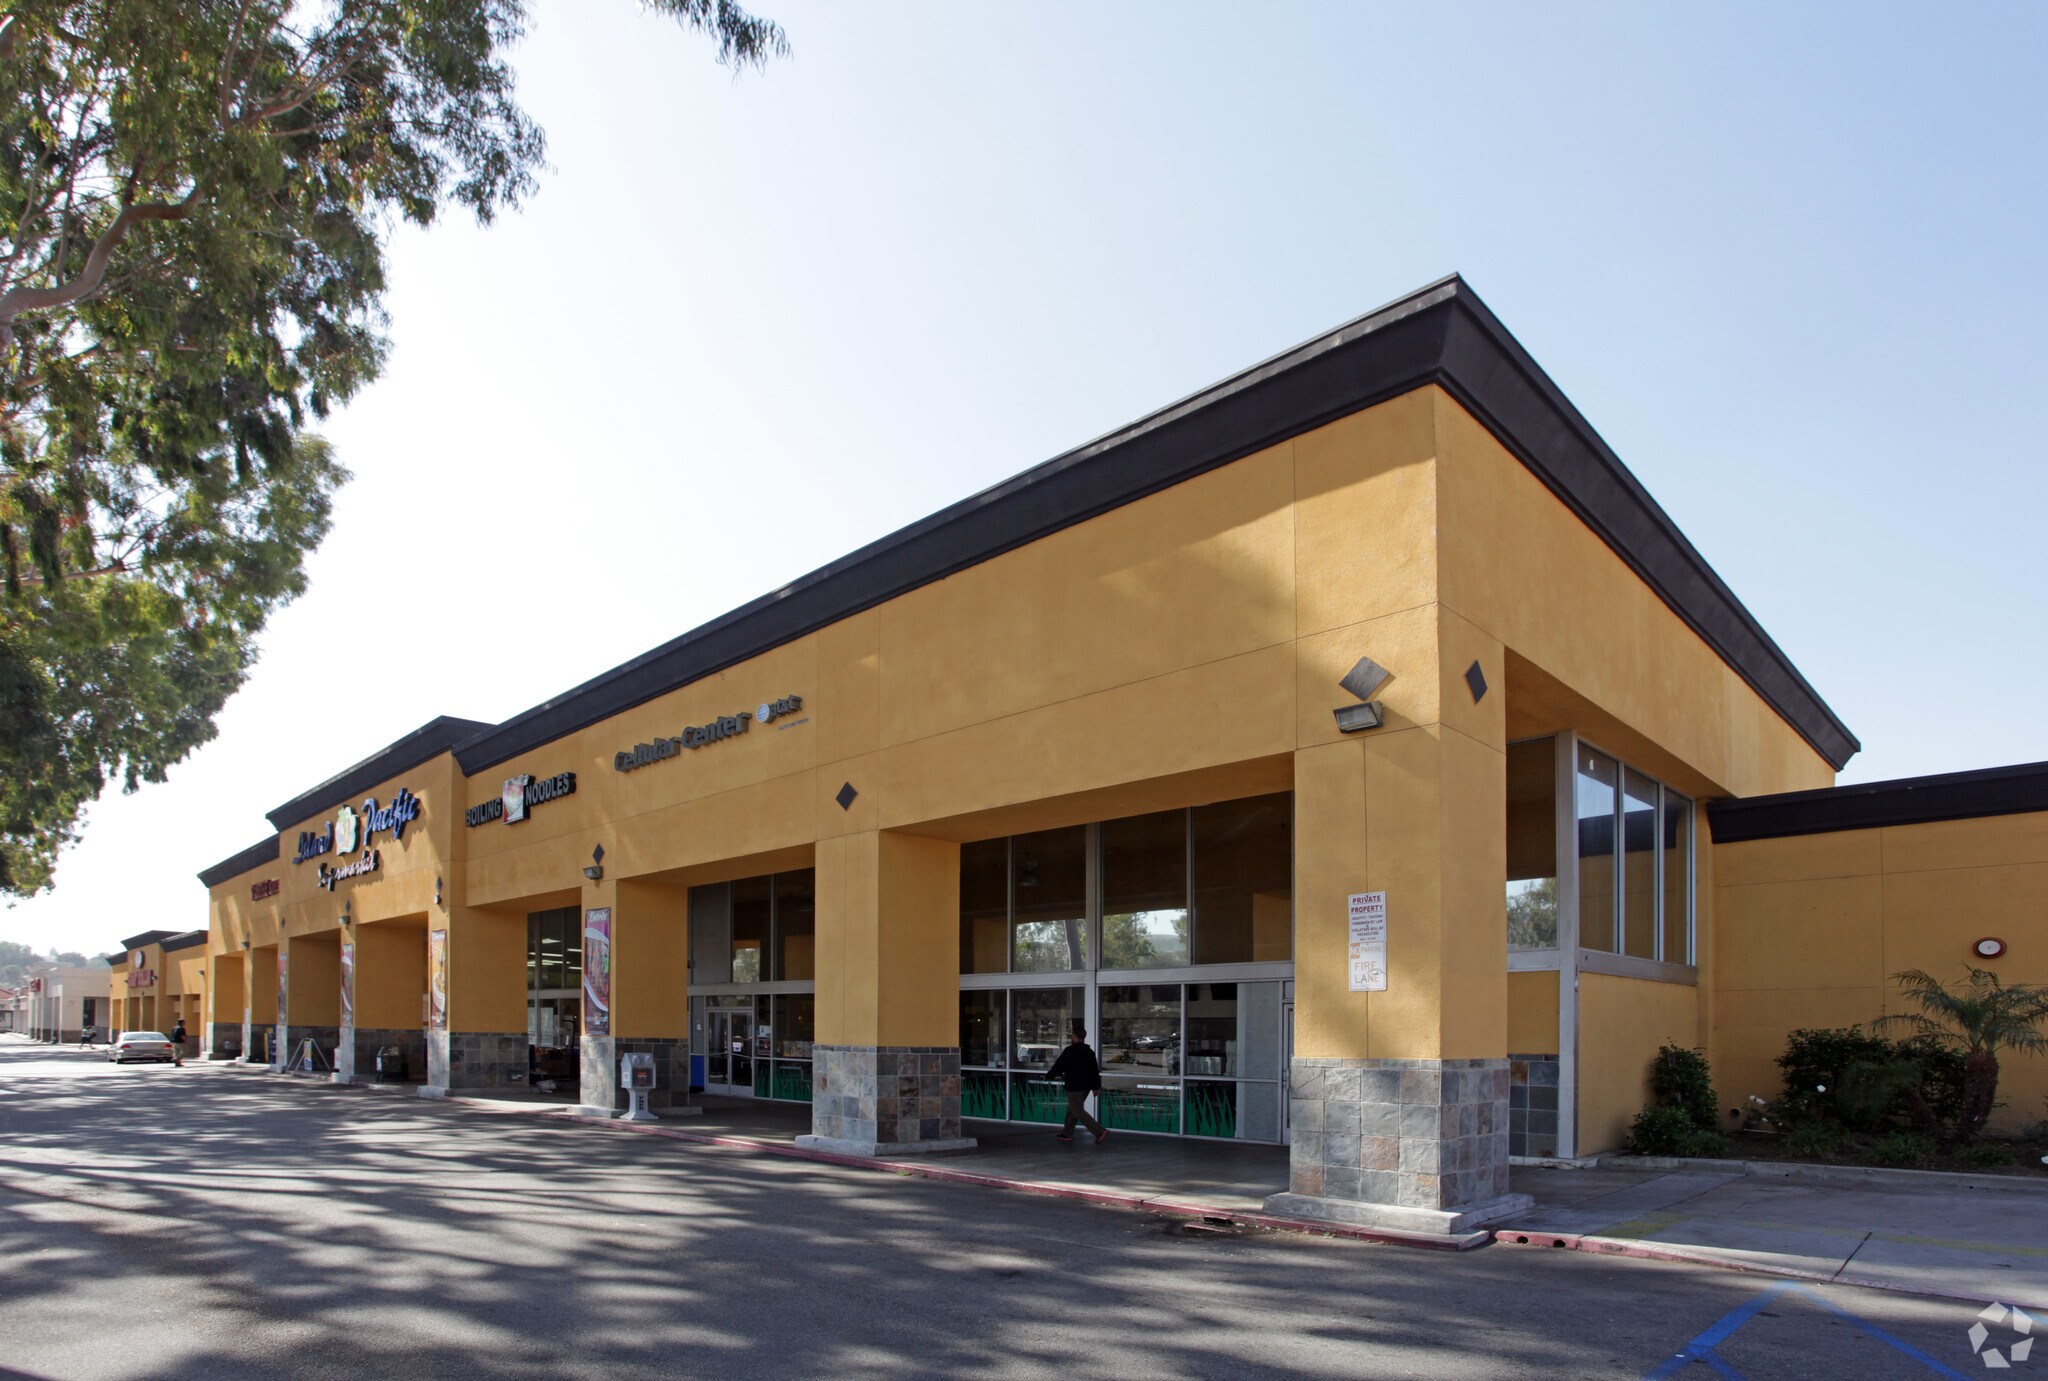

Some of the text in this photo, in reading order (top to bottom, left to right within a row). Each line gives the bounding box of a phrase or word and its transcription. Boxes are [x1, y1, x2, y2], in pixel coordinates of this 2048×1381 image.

[614, 736, 682, 773] Cellular
[682, 711, 752, 750] Center
[465, 772, 577, 828] BOILING NOODLES
[361, 788, 420, 846] Pacific
[1352, 895, 1381, 904] PRIVATE
[1351, 905, 1383, 913] PROPERTY
[1350, 945, 1360, 957] NO
[1354, 961, 1378, 971] FIRE
[1355, 973, 1380, 984] LANE
